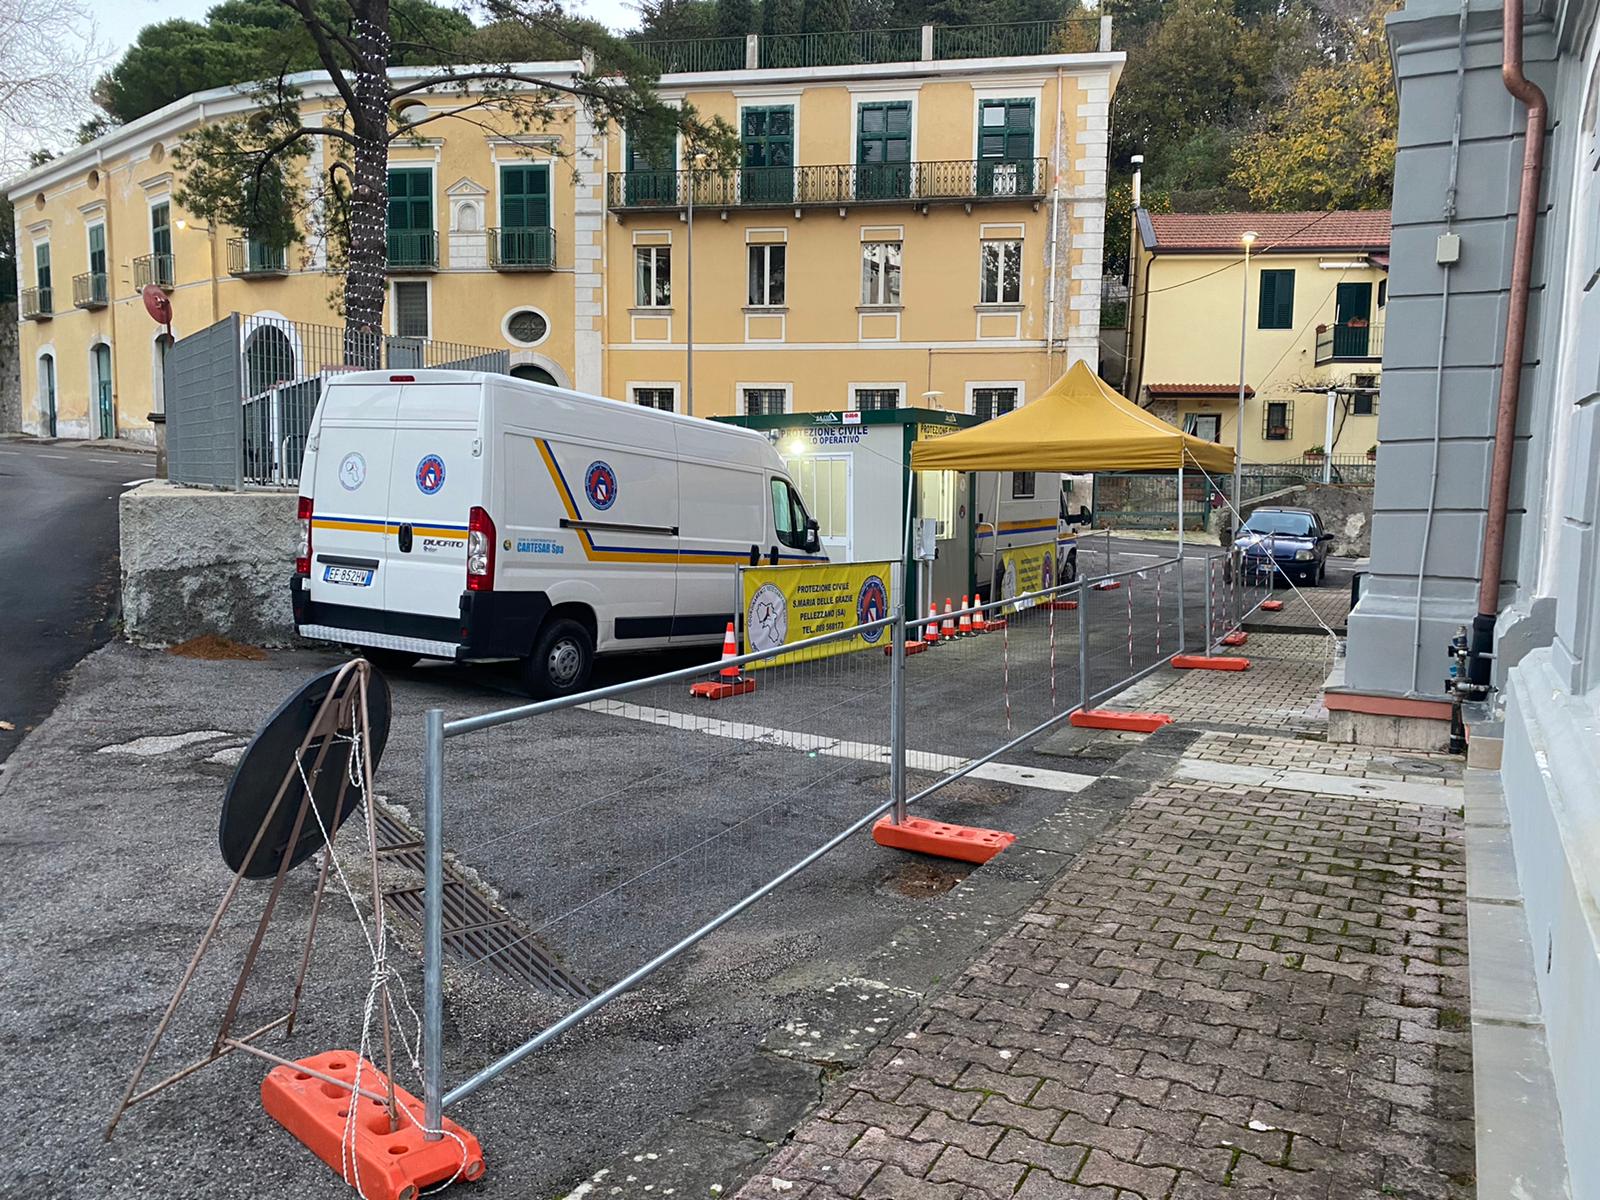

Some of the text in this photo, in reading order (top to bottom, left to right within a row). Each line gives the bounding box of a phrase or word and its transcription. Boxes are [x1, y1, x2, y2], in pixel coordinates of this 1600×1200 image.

[780, 425, 868, 438] PROTEZIONE CIVILE
[819, 435, 860, 445] OPERATIVO
[423, 538, 464, 549] DUCATO
[797, 582, 849, 594] PROTEZIONE CIVILE
[816, 596, 834, 606] DELLE
[834, 594, 854, 604] GRAZIE
[799, 608, 846, 621] PELLEZZANO (SA)
